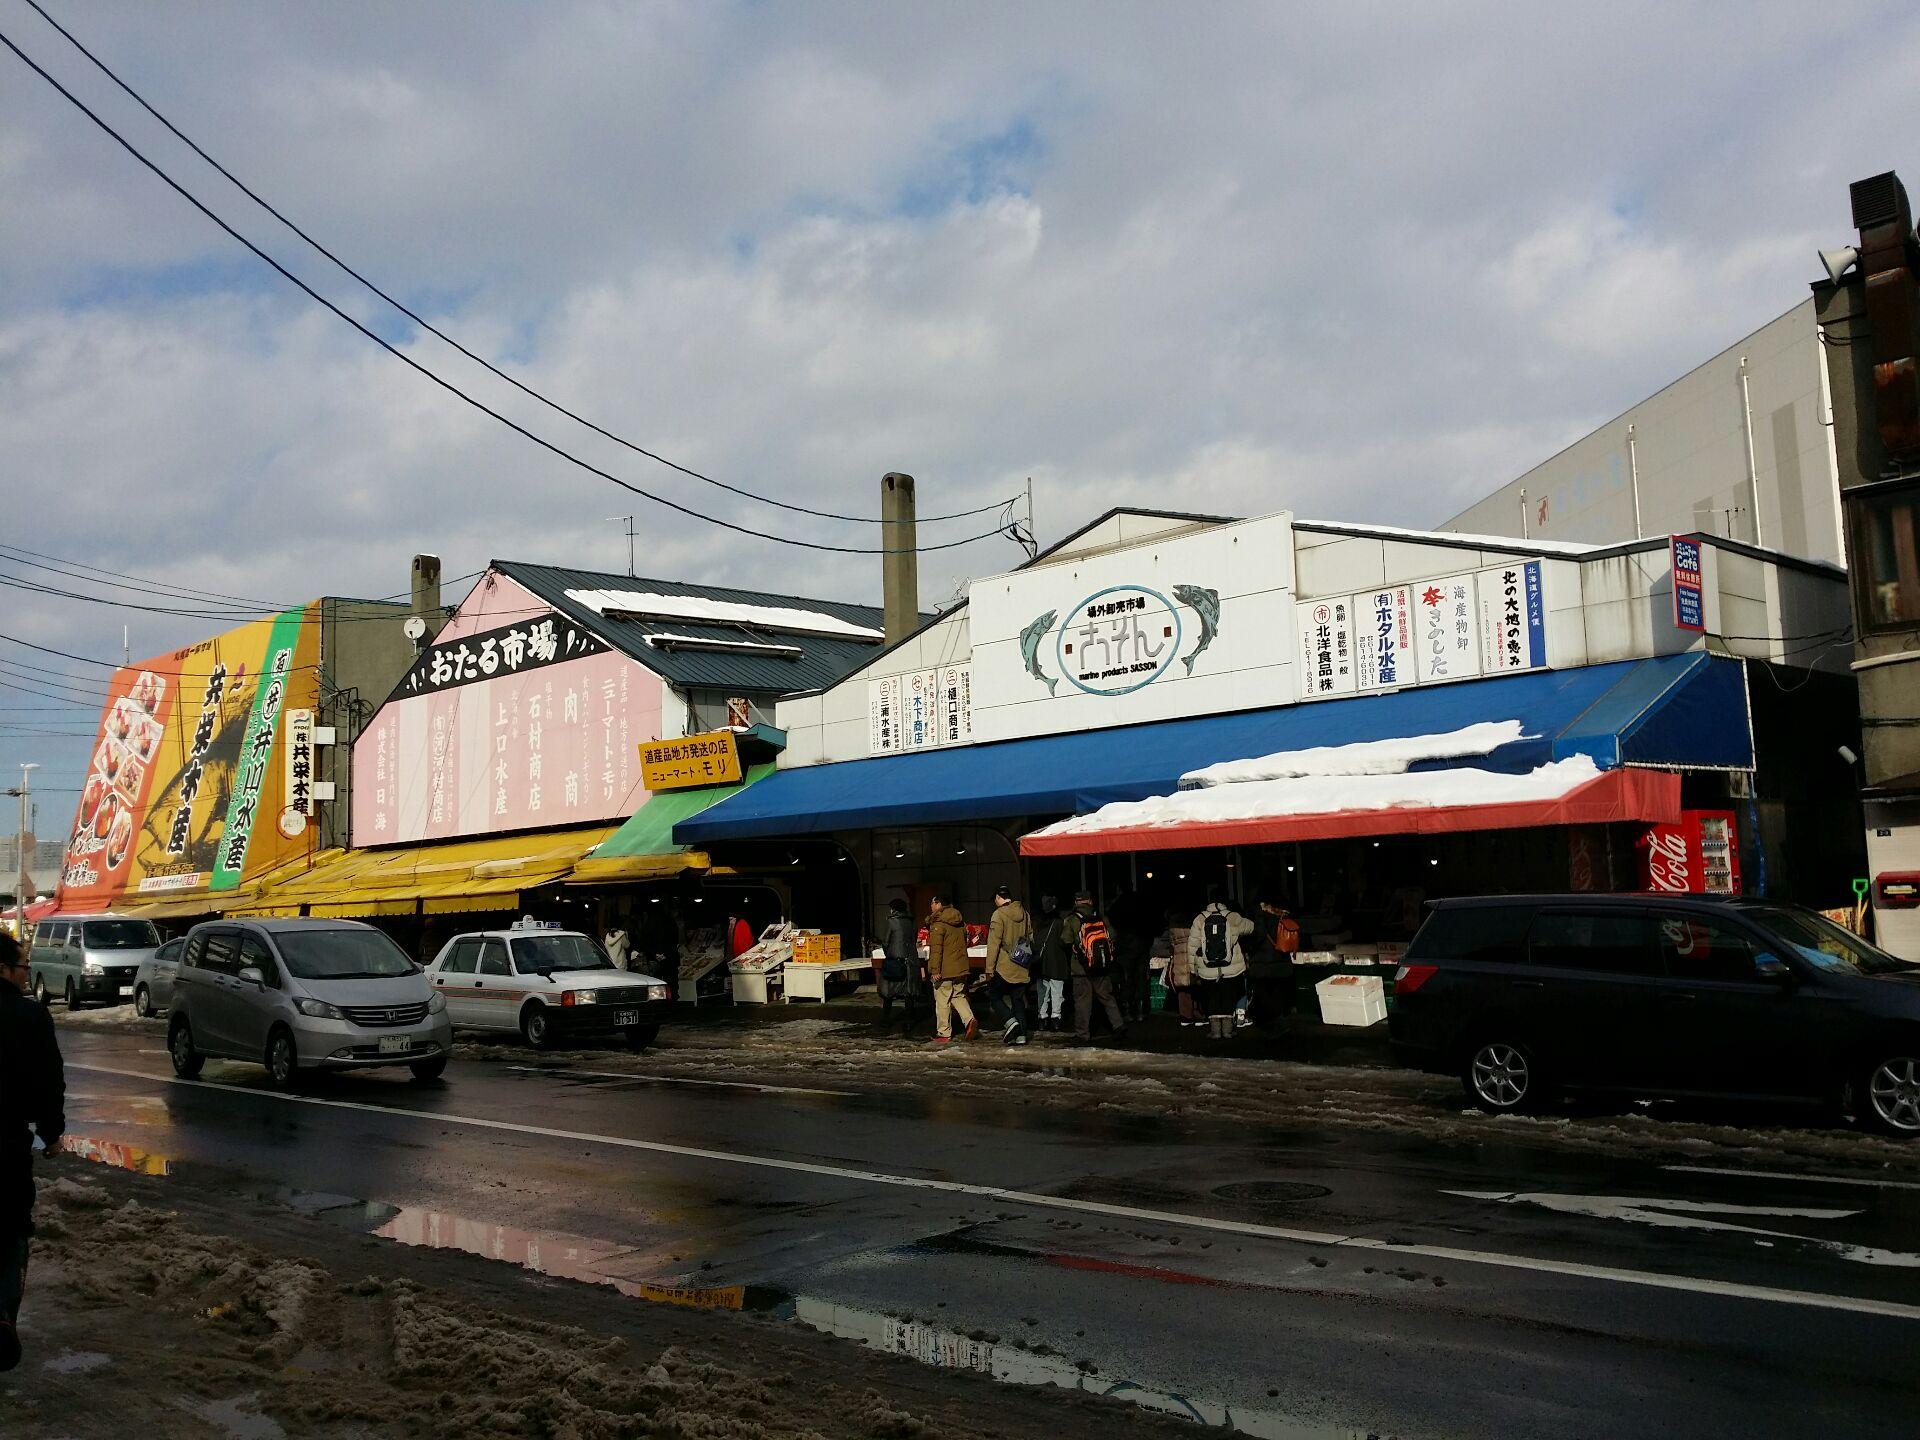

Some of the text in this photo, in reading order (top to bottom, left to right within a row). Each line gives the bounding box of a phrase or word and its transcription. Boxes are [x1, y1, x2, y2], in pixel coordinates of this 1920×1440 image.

[1086, 596, 1146, 618] 場外卸売市場
[1453, 585, 1469, 651] 海産物卸
[1502, 570, 1521, 667] 北の大地の恵み
[1527, 566, 1541, 627] 北海道グルメ便
[429, 619, 558, 686] おたる市場
[1079, 660, 1158, 681] marine products SASSON
[602, 679, 616, 801] ニューマート・モリ
[913, 695, 923, 744] 木下商店
[948, 687, 958, 740] 樋口商店
[377, 727, 386, 781] 株式会社
[495, 702, 508, 815] 上口水産
[528, 694, 542, 811] 石村商店
[645, 739, 729, 765] 道産品地方発送の店
[652, 758, 726, 782] ニューマート・モリ
